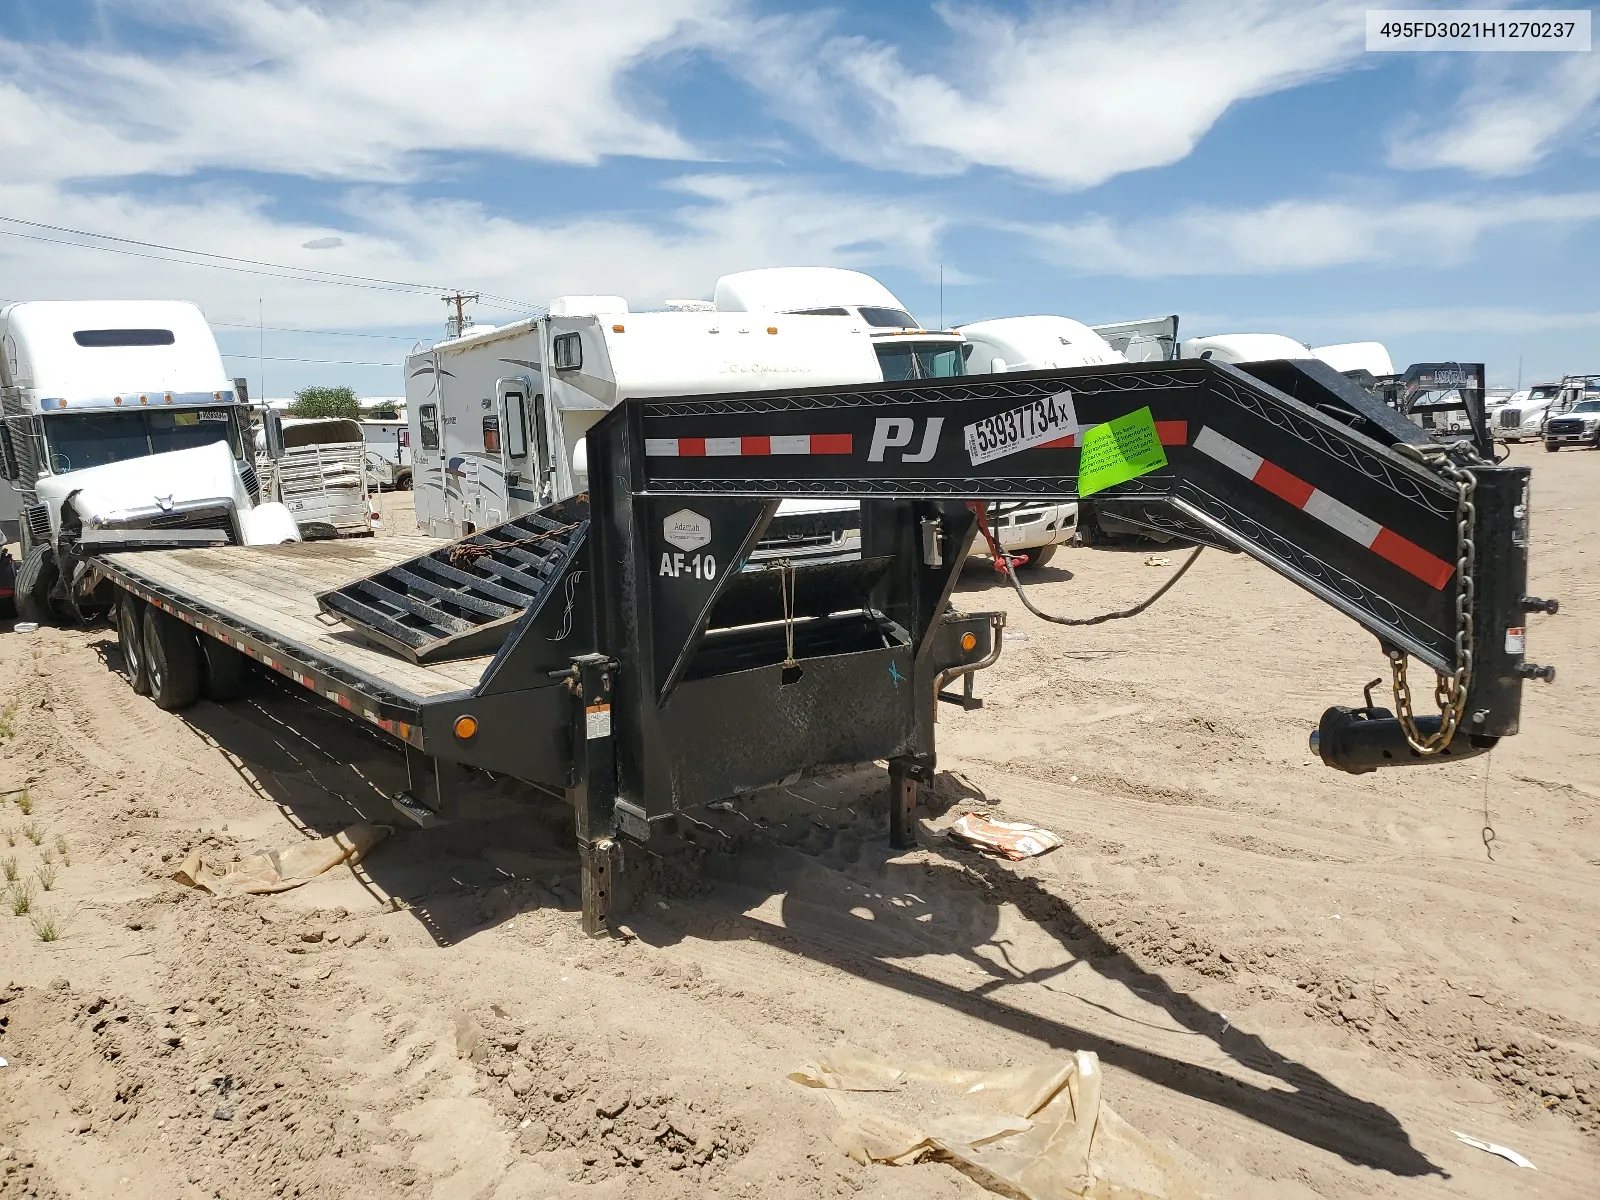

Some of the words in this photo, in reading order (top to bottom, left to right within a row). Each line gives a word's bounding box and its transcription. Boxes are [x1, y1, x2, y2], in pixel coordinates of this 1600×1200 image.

[866, 416, 946, 463] PJ
[975, 397, 1059, 452] 53937734
[659, 552, 716, 581] AF-10
